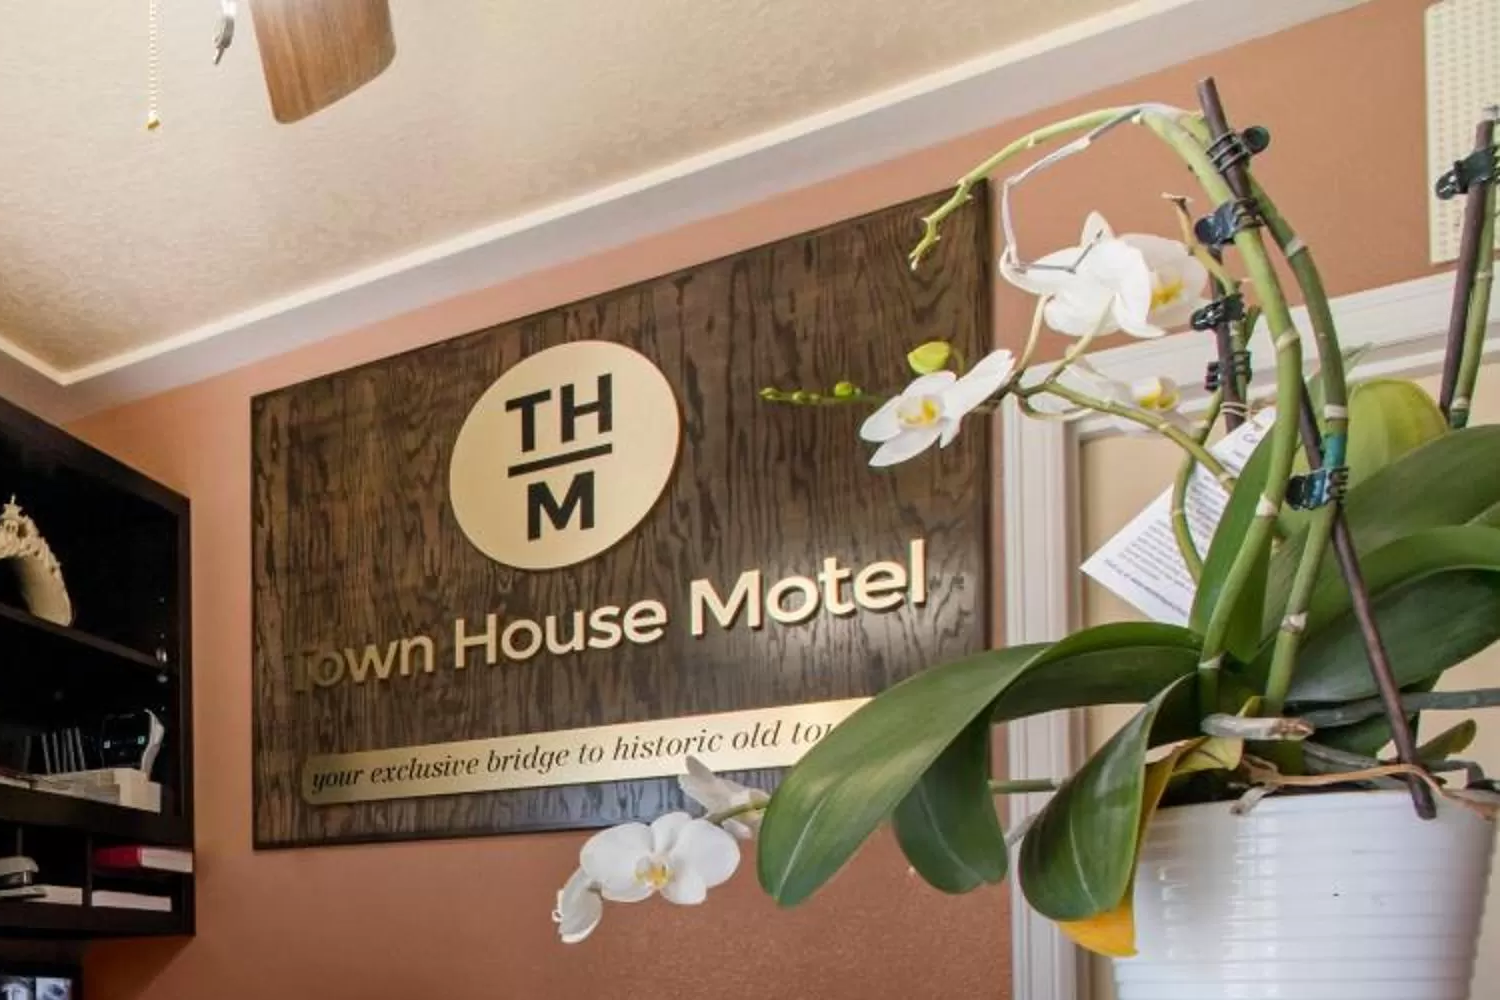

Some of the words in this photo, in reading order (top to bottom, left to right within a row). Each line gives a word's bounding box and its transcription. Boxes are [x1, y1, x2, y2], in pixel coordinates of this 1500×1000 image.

[504, 372, 613, 453] TH
[526, 470, 596, 542] M
[284, 634, 436, 692] Town
[455, 598, 668, 669] House
[690, 538, 928, 637] Motel
[311, 766, 364, 794] your
[370, 754, 480, 784] exclusive
[486, 744, 569, 776] bridge
[579, 742, 605, 765] to
[612, 724, 724, 763] historic
[732, 719, 783, 748] old
[791, 720, 834, 745] to
